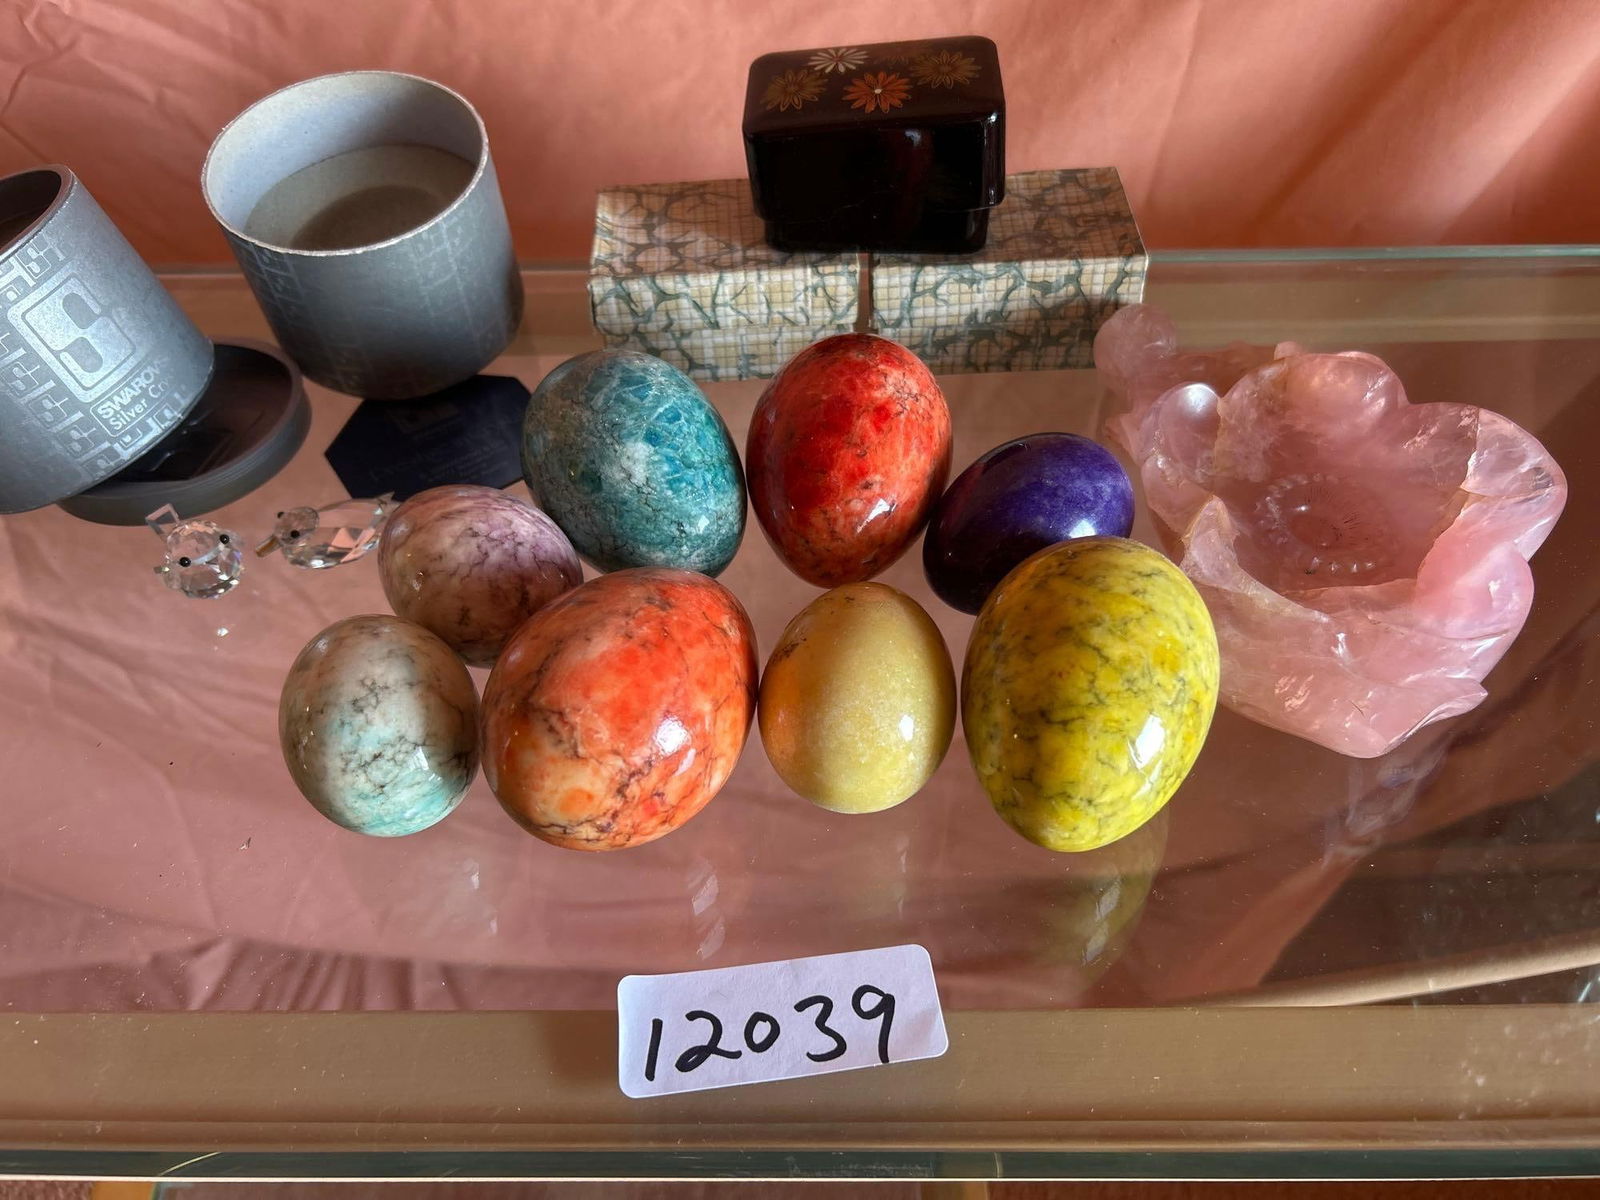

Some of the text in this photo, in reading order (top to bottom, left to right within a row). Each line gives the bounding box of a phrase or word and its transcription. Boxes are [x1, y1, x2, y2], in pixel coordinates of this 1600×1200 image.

[98, 358, 162, 419] SWAROV
[110, 399, 148, 430] Silver
[645, 984, 896, 1081] 12039
